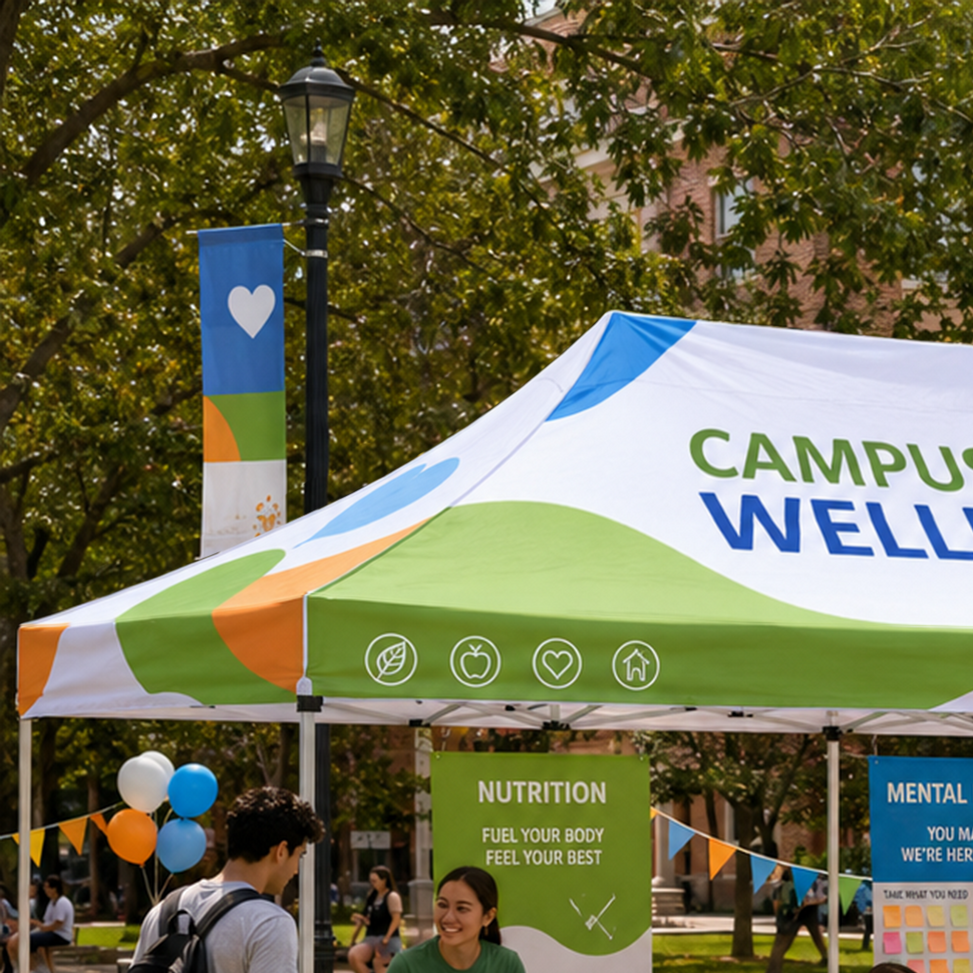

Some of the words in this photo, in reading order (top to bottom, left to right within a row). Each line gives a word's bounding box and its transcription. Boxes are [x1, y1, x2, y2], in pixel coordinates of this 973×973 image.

[478, 780, 607, 804] NUTRITION
[887, 781, 968, 804] MENTAL
[481, 827, 519, 844] FUEL
[520, 827, 561, 844] YOUR
[564, 827, 605, 844] BODY
[926, 825, 955, 842] YOU
[485, 849, 521, 866] FEEL
[522, 849, 564, 866] YOUR
[567, 849, 603, 866] BEST
[900, 846, 943, 863] WE'RE
[929, 889, 946, 900] YOU
